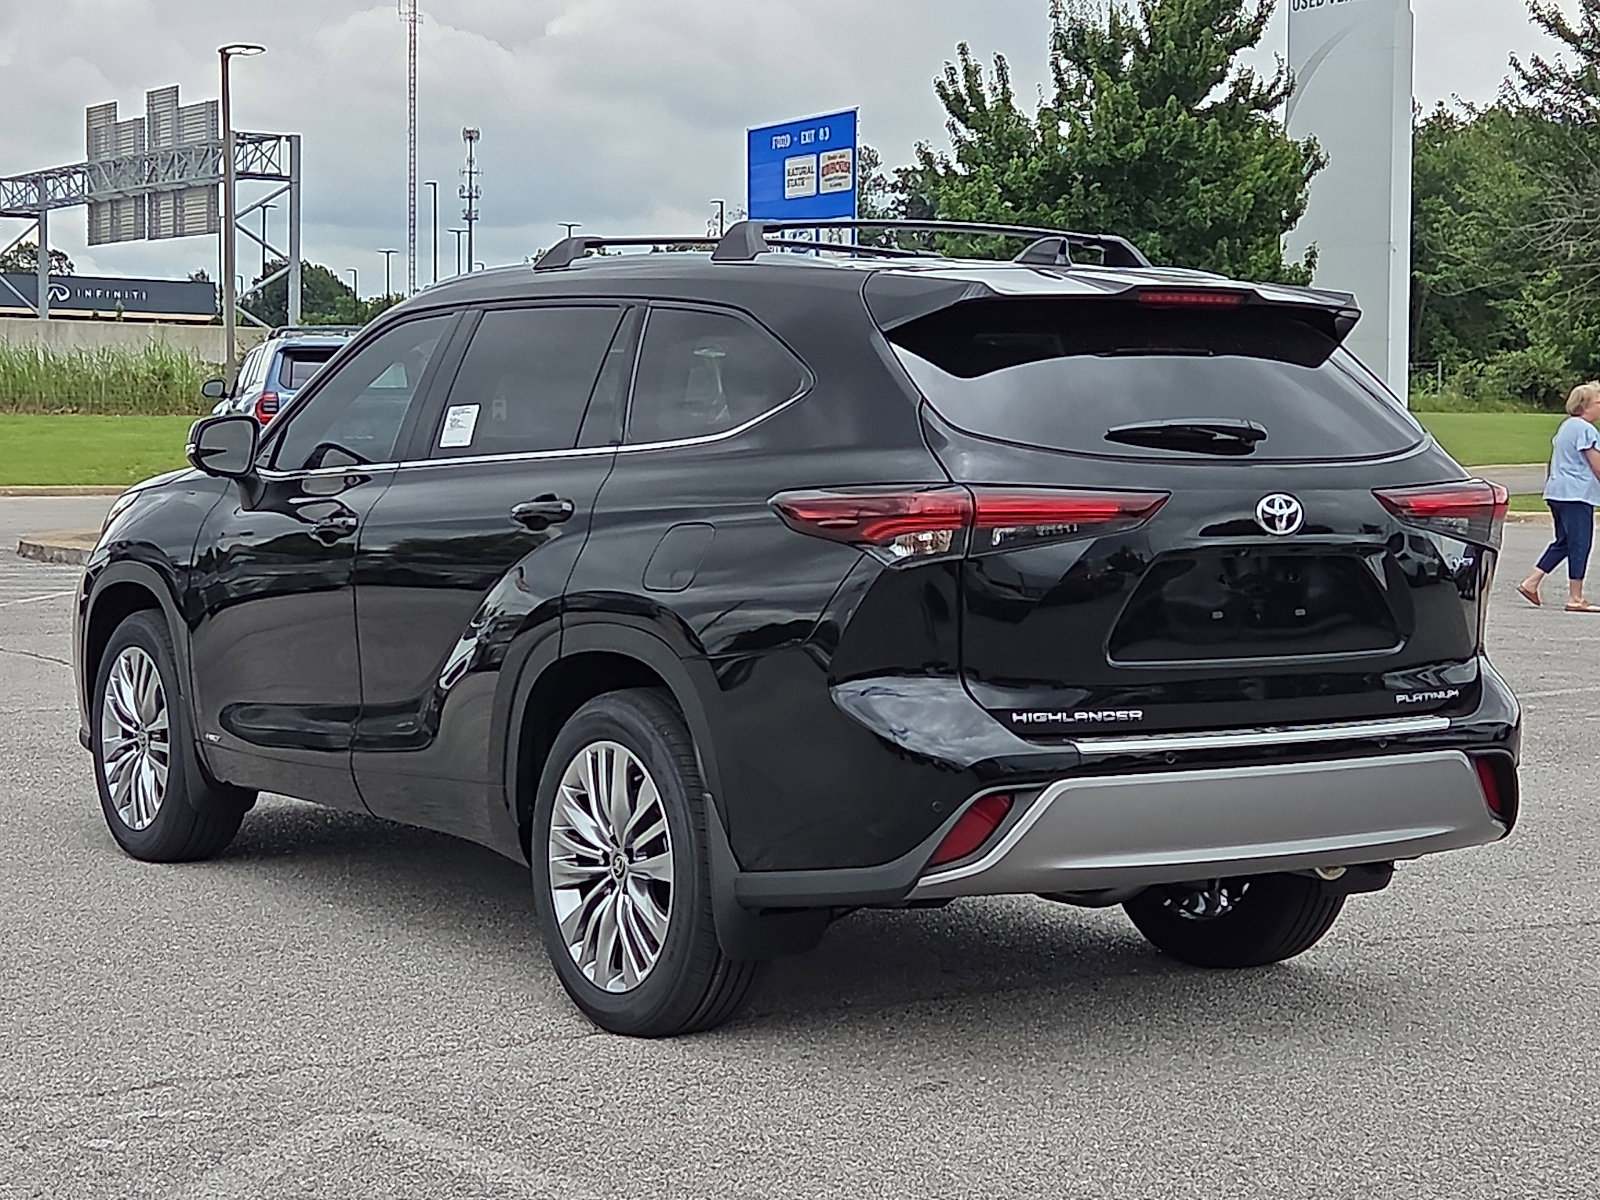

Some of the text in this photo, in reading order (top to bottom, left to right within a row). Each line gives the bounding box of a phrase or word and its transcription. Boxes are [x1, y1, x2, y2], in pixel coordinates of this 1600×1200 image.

[801, 129, 815, 144] EXIT
[787, 165, 815, 177] NATURAL
[787, 177, 805, 188] STATE
[75, 288, 148, 300] INFINITI
[1395, 689, 1459, 704] PLATINUM
[1011, 710, 1143, 724] HIGHLANDER
